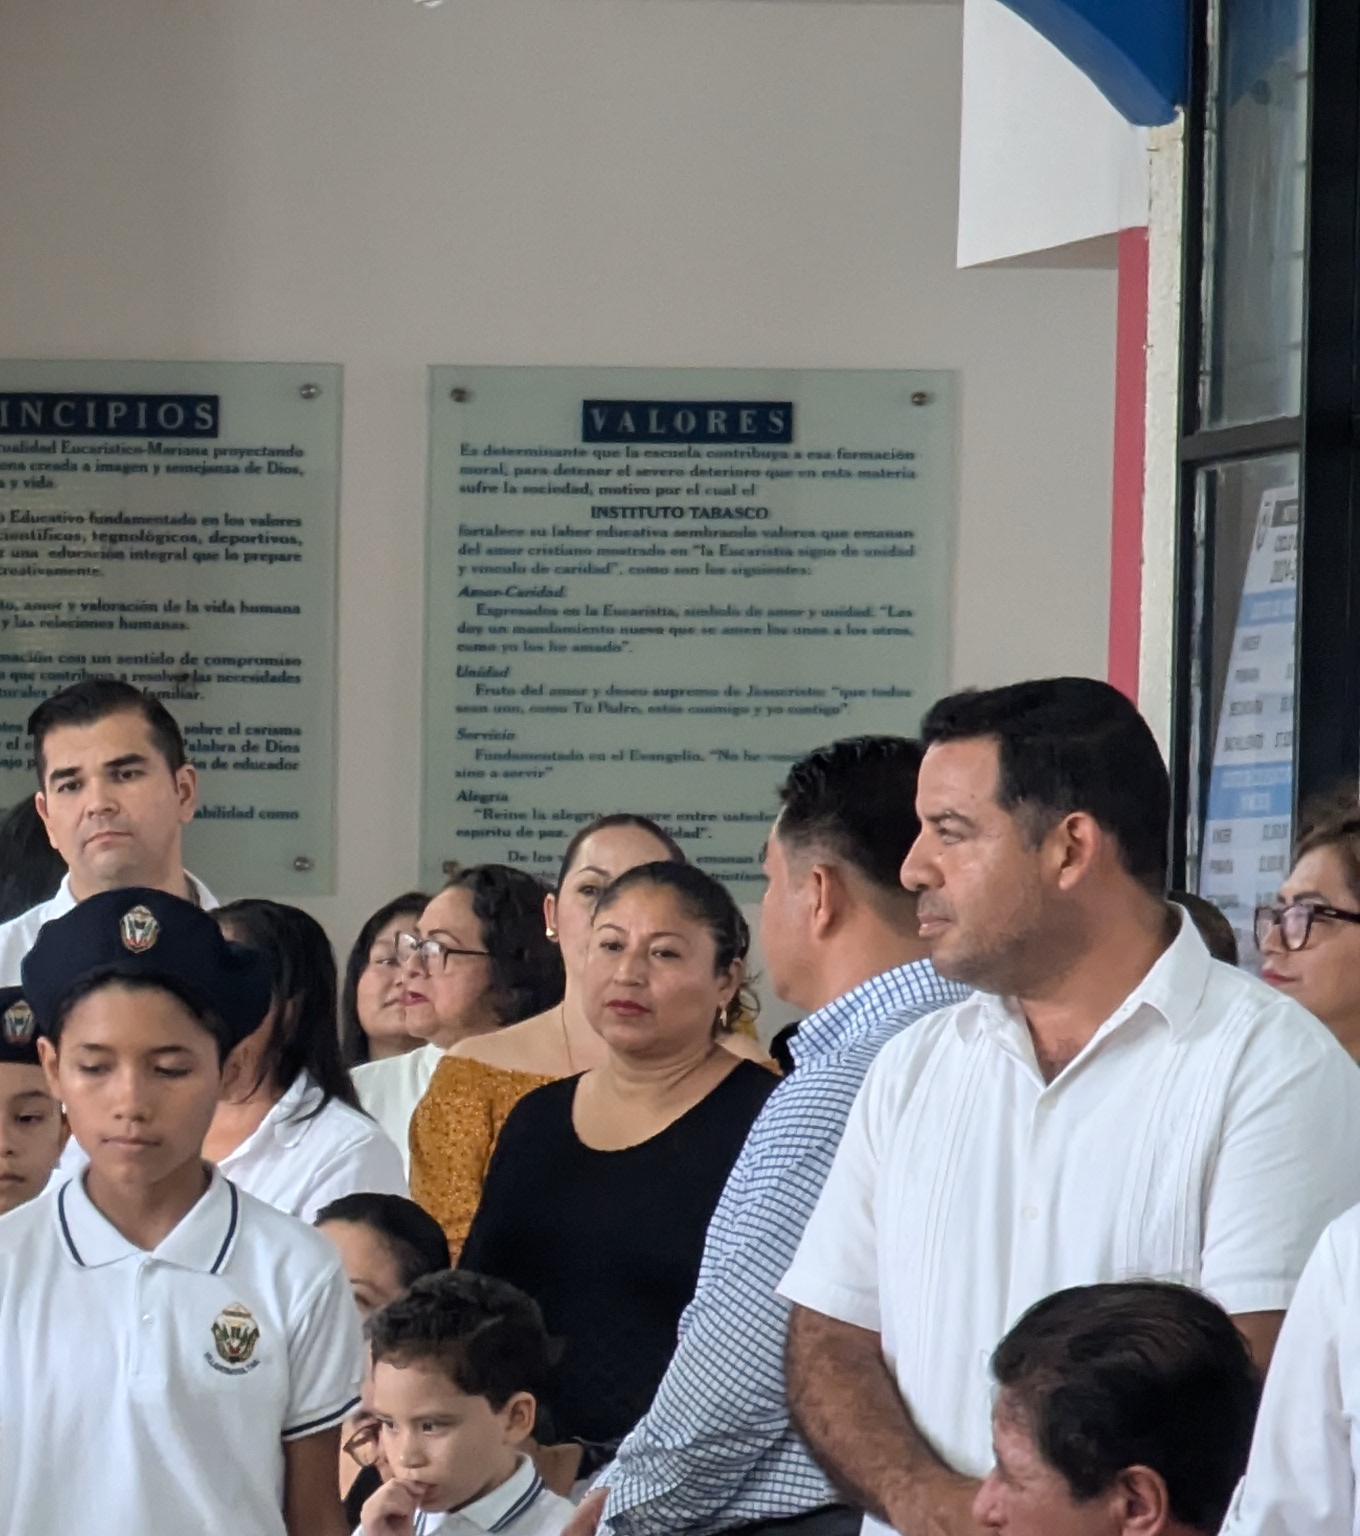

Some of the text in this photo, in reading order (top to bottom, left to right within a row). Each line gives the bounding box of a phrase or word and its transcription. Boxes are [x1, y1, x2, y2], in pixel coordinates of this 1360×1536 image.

[590, 408, 785, 434] VALORES
[591, 505, 768, 519] INSTITUTO TABASCO
